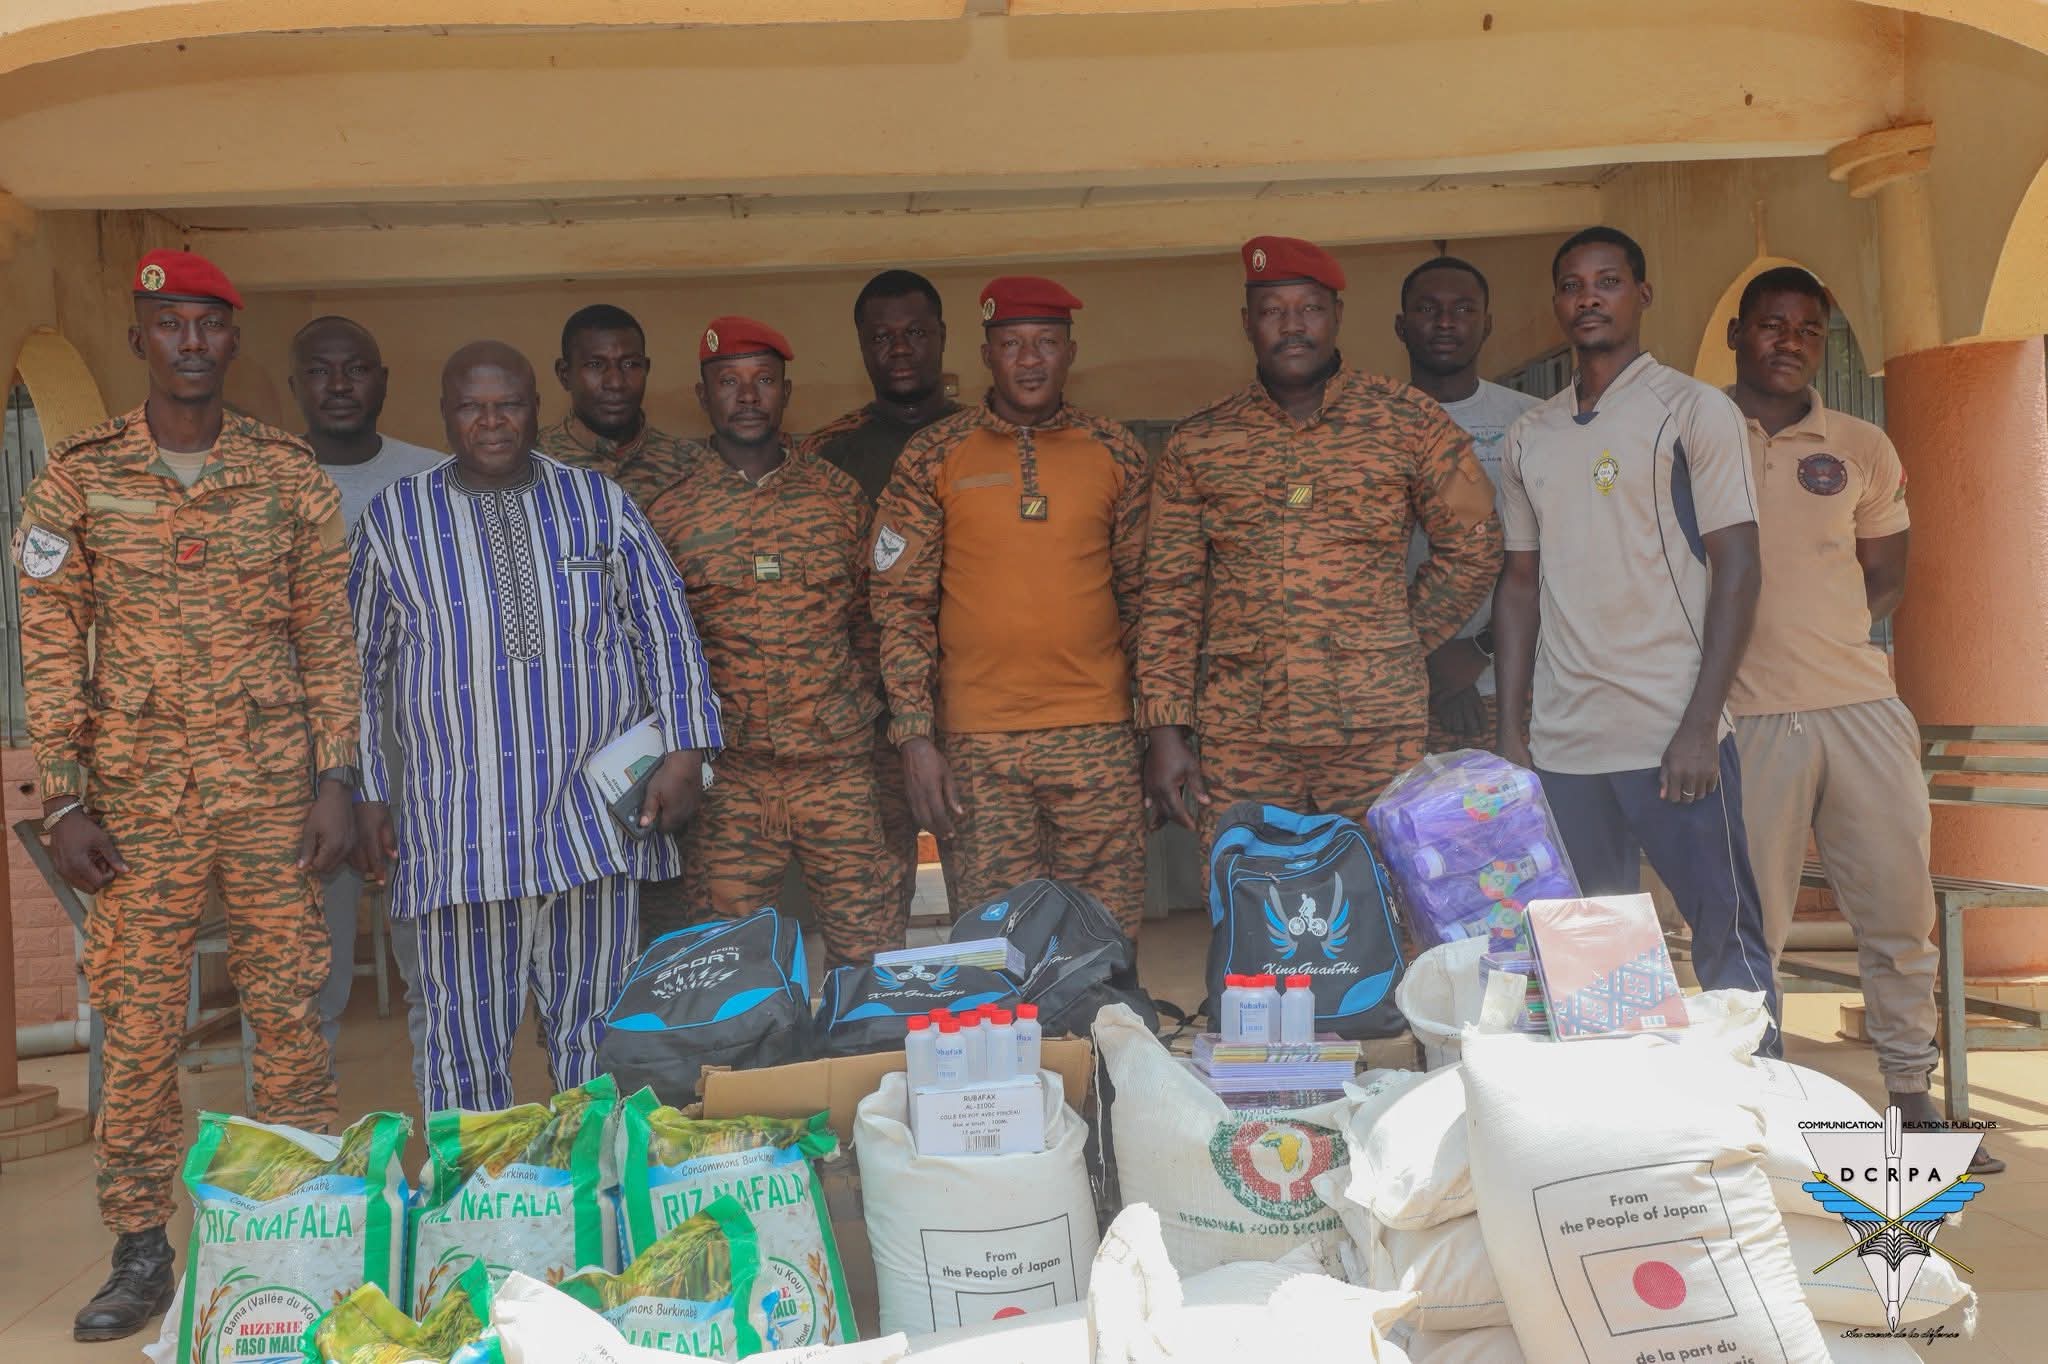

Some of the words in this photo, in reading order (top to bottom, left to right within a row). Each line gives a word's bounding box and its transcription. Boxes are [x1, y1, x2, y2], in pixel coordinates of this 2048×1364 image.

[1263, 961, 1359, 976] XingGuanHu
[460, 1189, 563, 1222] NAFALA
[662, 1188, 703, 1230] RIZ
[1609, 1192, 1649, 1206] From
[205, 1209, 241, 1243] RIZ
[245, 1203, 353, 1241] NAFALA
[1560, 1221, 1584, 1235] the
[1586, 1211, 1640, 1230] People
[1643, 1205, 1659, 1220] of
[1663, 1203, 1708, 1219] Japan
[942, 1266, 961, 1278] the
[965, 1266, 1008, 1280] People
[1011, 1262, 1024, 1276] of
[1027, 1257, 1061, 1273] Japan
[985, 1251, 1017, 1262] From
[223, 1306, 247, 1336] Bama
[286, 1296, 301, 1309] du
[240, 1321, 303, 1337] RIZERIE
[235, 1337, 266, 1356] FASO
[1635, 1351, 1656, 1364] de
[1658, 1348, 1676, 1362] la
[1679, 1343, 1713, 1363] part
[1717, 1339, 1737, 1353] du
